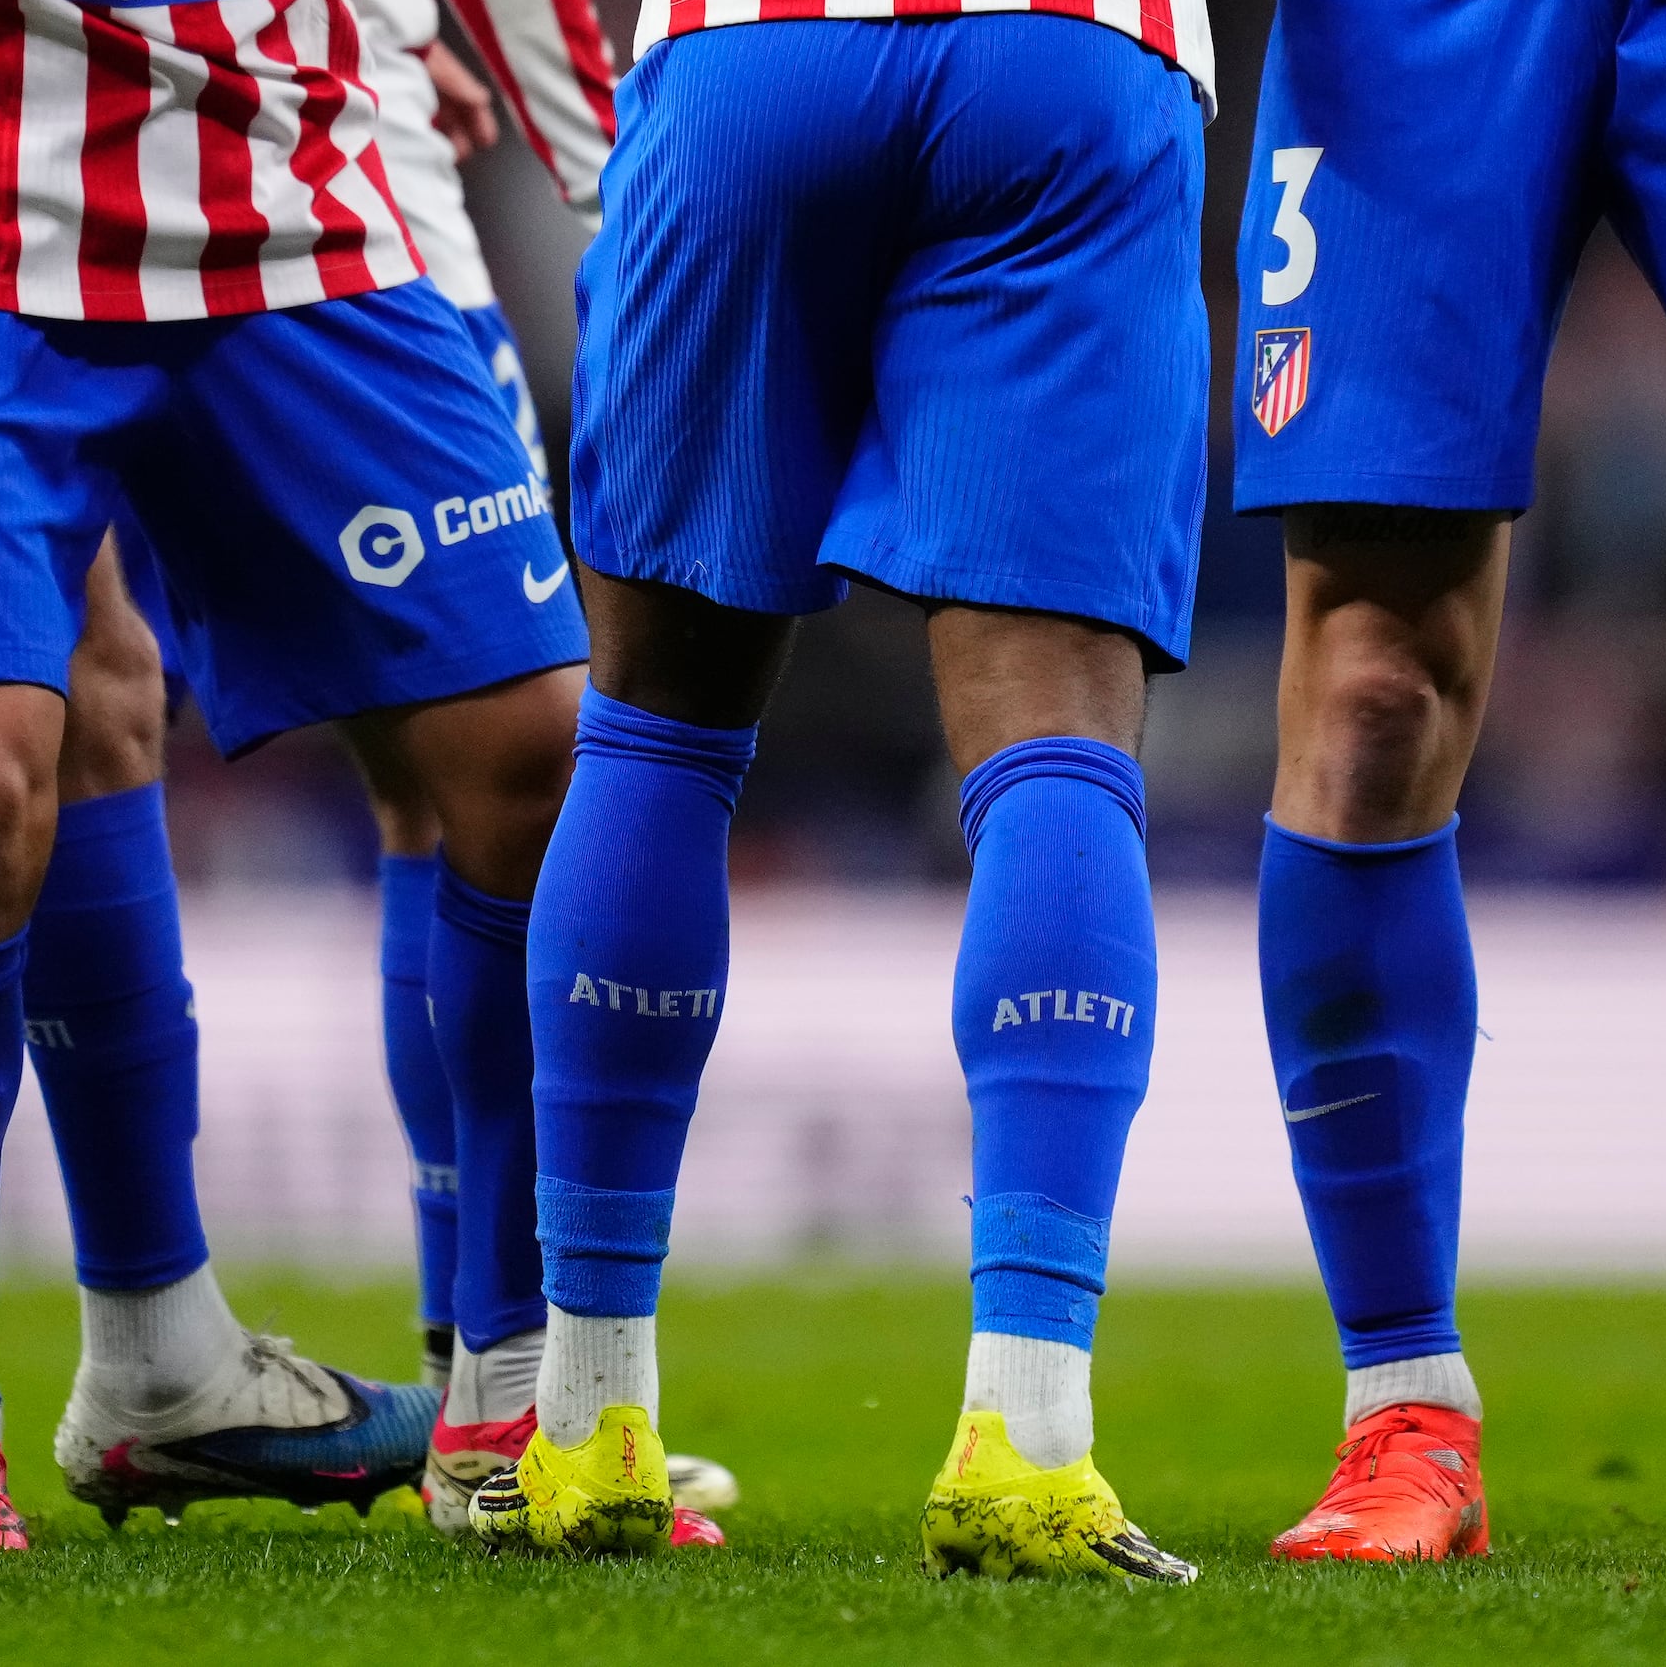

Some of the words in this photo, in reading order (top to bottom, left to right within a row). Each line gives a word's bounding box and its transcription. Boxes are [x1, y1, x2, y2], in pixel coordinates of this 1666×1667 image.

[1261, 146, 1325, 306] 3
[569, 972, 717, 1020] ATLETI
[992, 988, 1135, 1038] ATLETI
